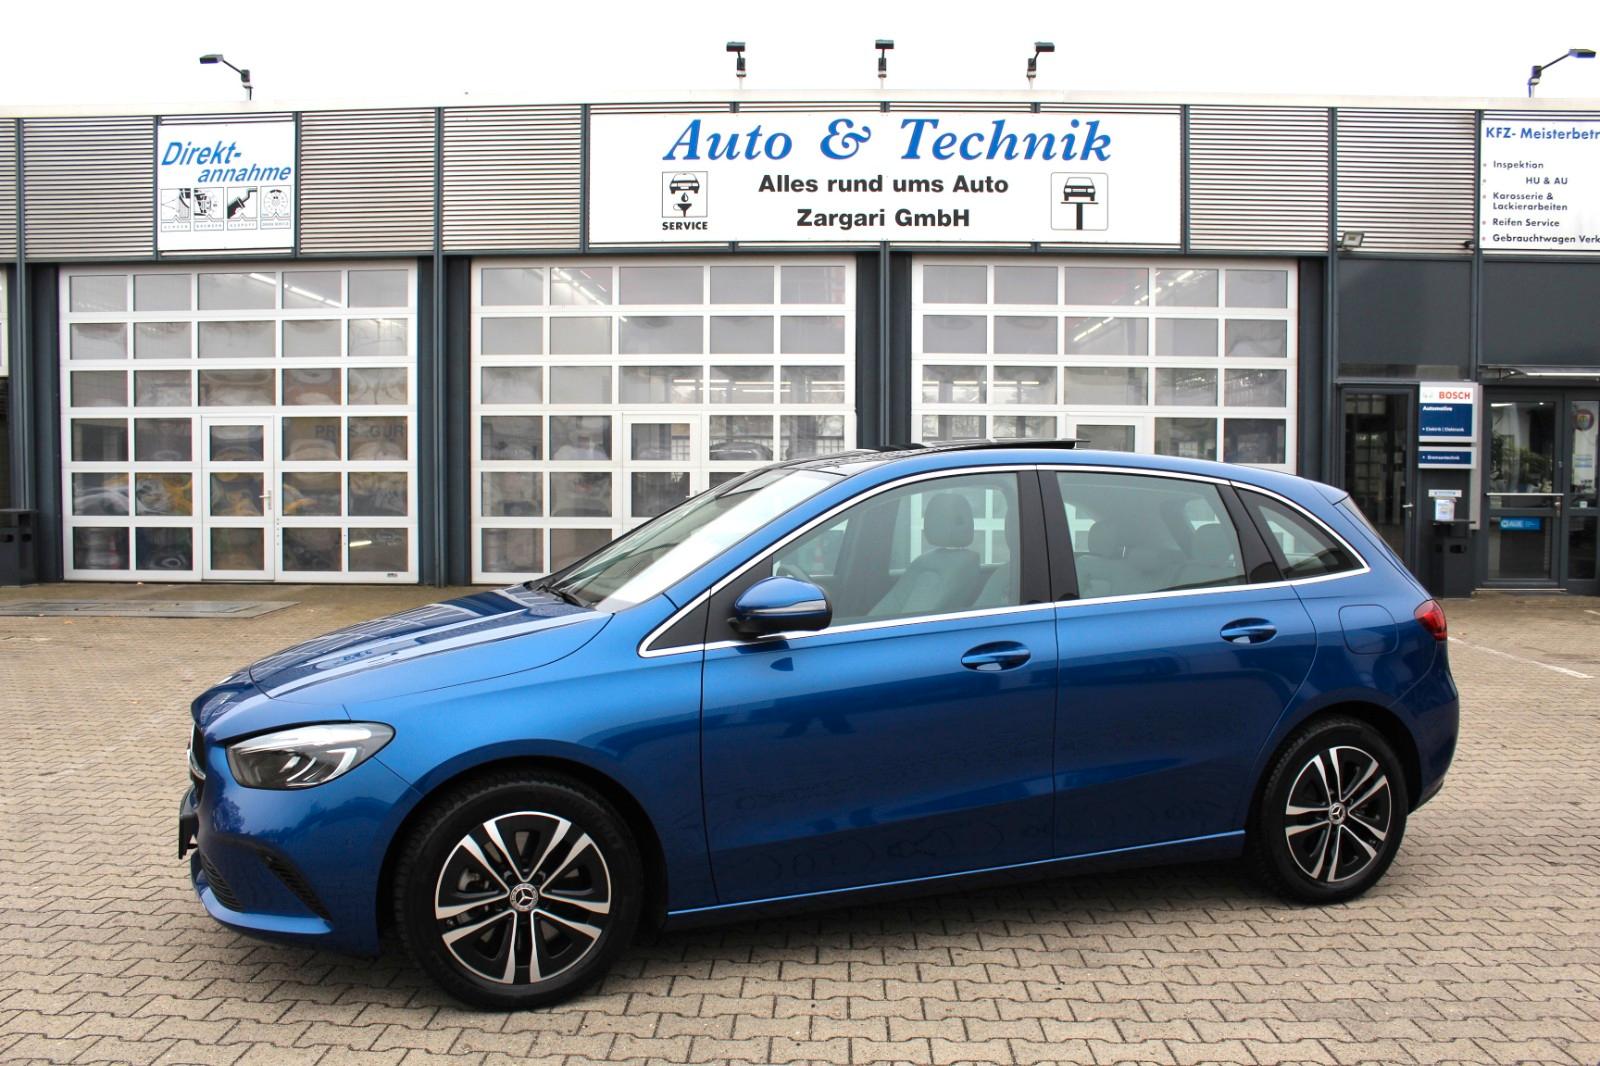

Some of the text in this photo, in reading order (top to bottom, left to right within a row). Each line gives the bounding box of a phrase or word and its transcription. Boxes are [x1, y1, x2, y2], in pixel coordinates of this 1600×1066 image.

[662, 115, 1112, 161] Auto & Technik
[1486, 127, 1517, 139] KFZ-
[161, 141, 242, 165] Direkt-
[1493, 160, 1544, 170] Inspektion
[197, 163, 292, 183] annahme
[758, 175, 1008, 193] Alles rund ums Auto
[1525, 177, 1568, 185] HU & AU
[1493, 192, 1554, 201] Karosserie &
[1493, 202, 1568, 211] Lackierarbeiten
[797, 209, 970, 231] Zargari GmbH
[1492, 218, 1560, 227] Reifen Service
[661, 222, 708, 231] SERVICE
[1492, 234, 1576, 245] Gebrauchtwagen
[1438, 391, 1471, 400] BOSCH
